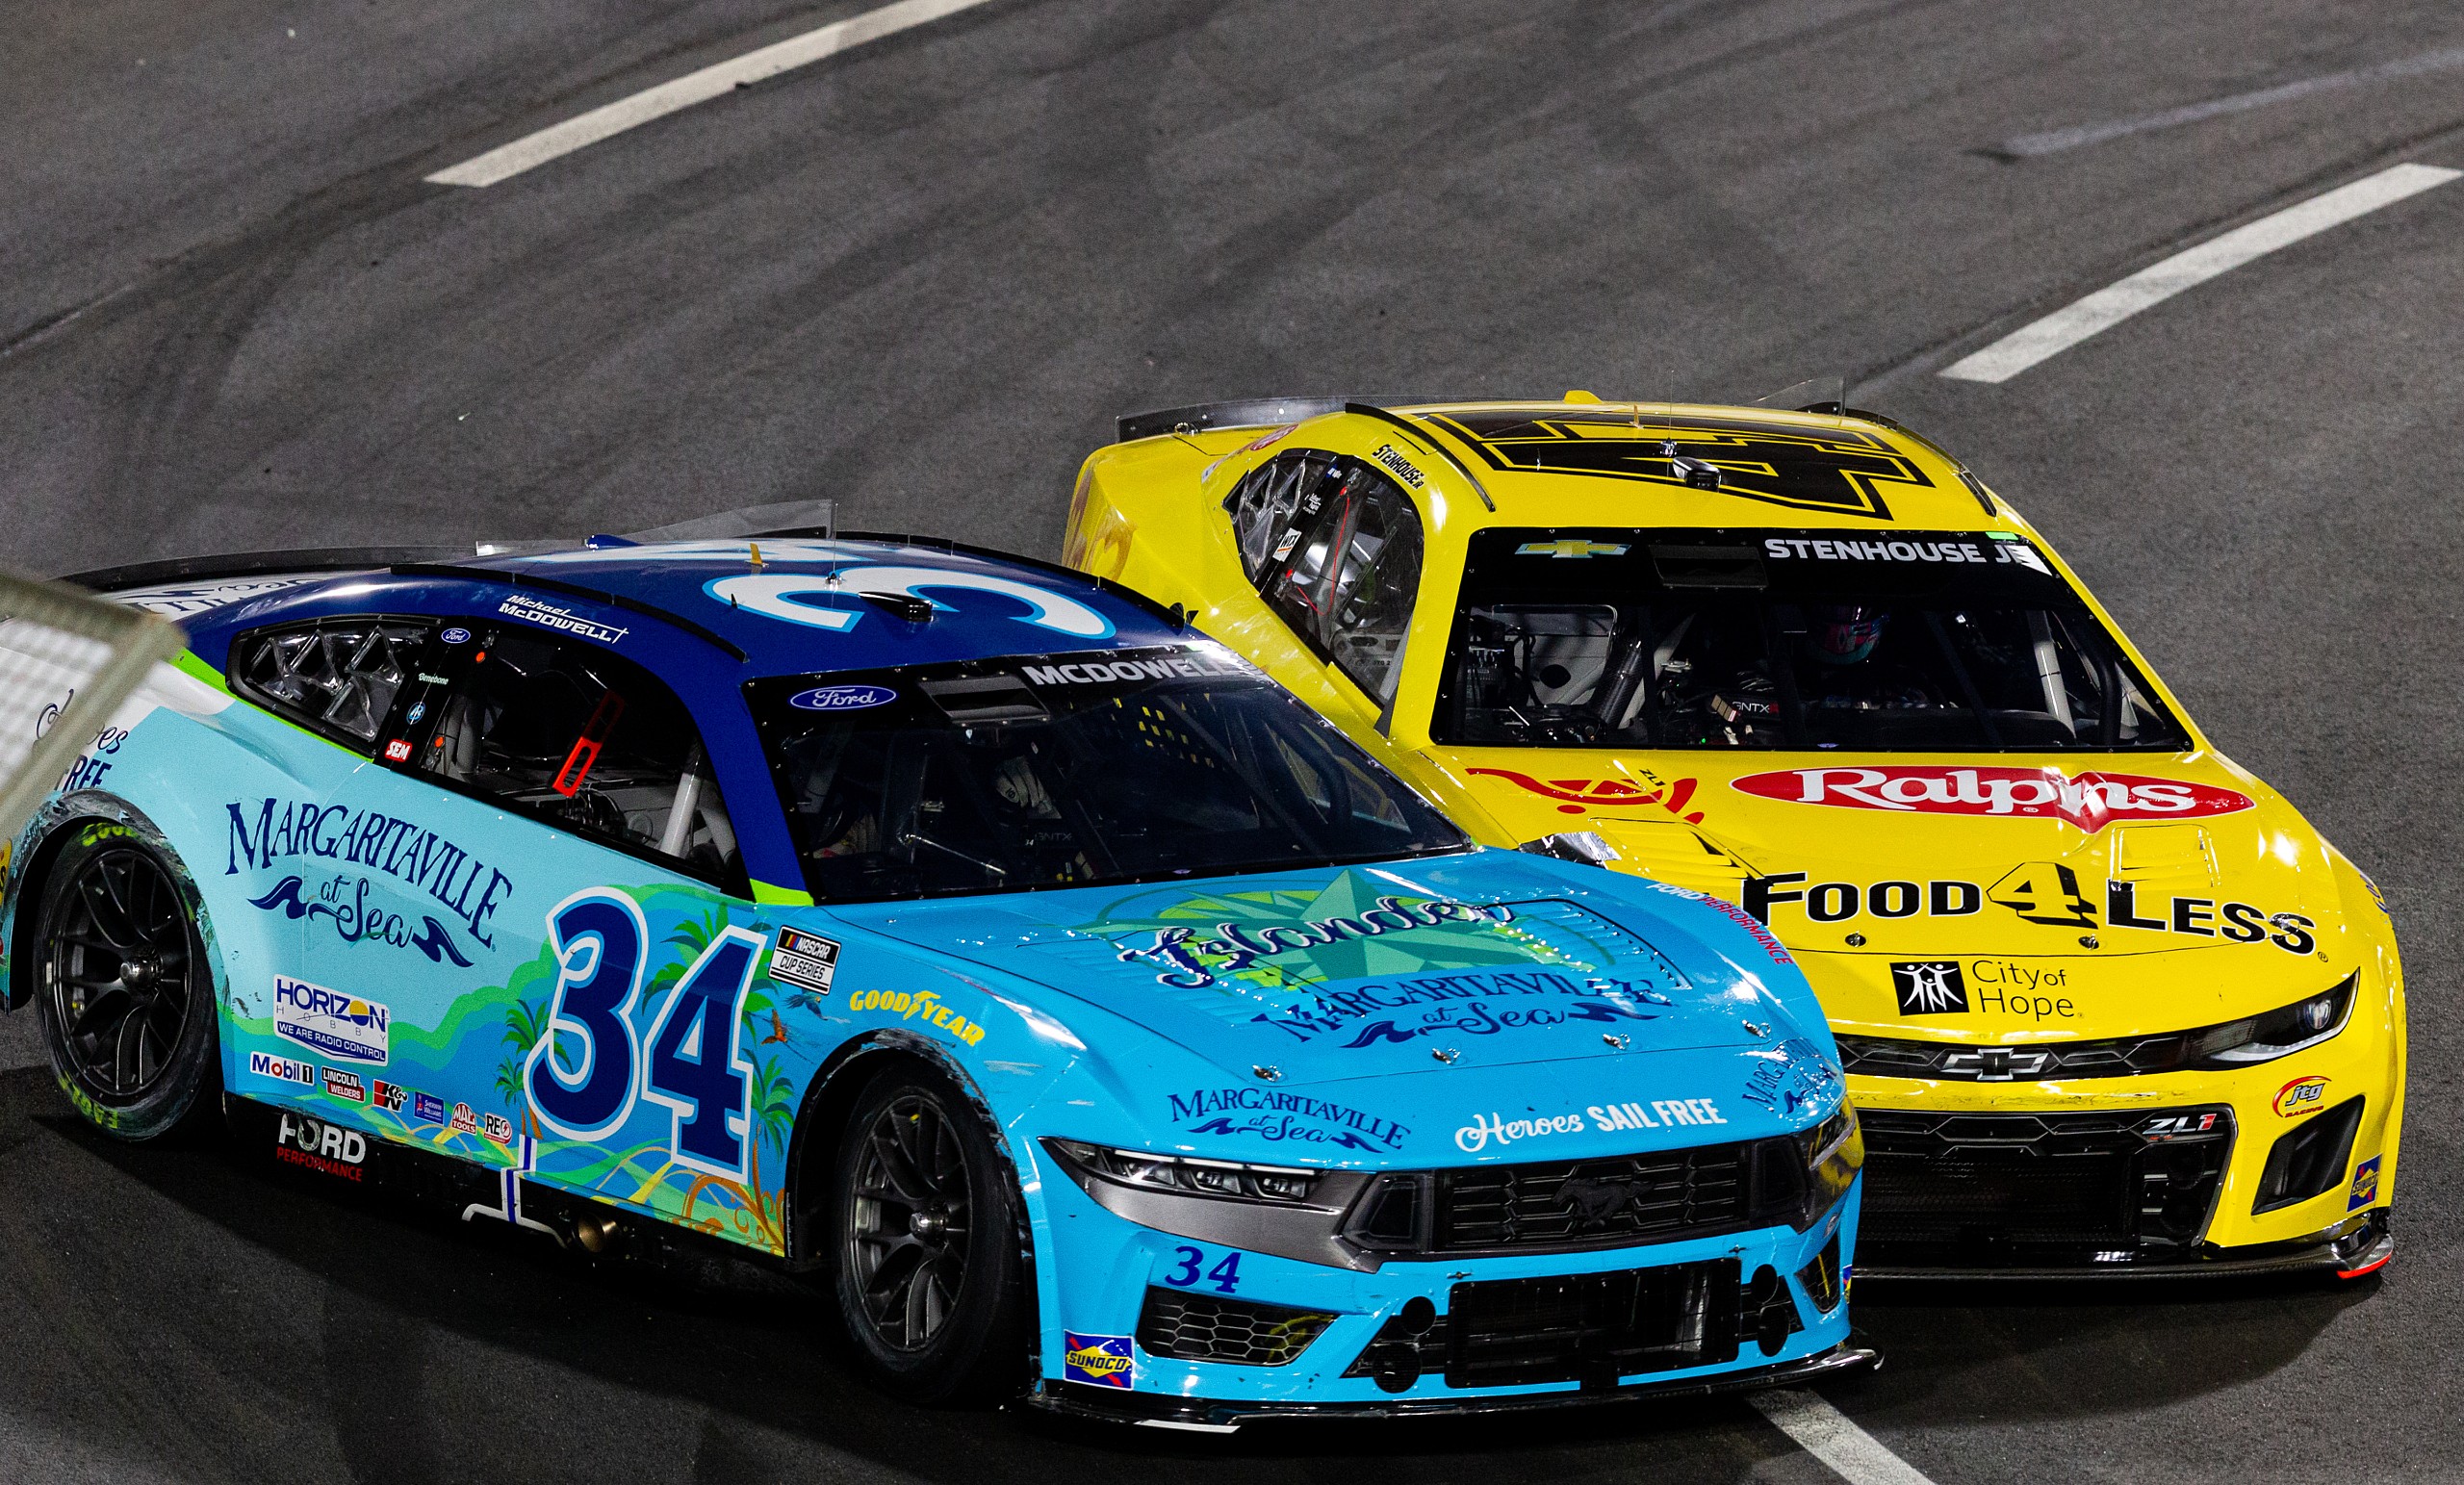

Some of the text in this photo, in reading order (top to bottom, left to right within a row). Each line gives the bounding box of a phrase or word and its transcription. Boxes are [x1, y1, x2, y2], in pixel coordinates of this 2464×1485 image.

[1372, 444, 1424, 484] STENHOUSE
[1764, 539, 1988, 563] STENHOUSE
[506, 595, 570, 616] Michael
[445, 629, 467, 641] Ford
[811, 688, 877, 707] Ford
[386, 742, 411, 760] SEM
[1639, 768, 1667, 787] ZL1
[225, 798, 512, 949] MARGARITAVILLE
[308, 875, 412, 948] at Sea
[1740, 871, 1982, 927] FOOD
[1987, 861, 2099, 930] 4
[2106, 878, 2318, 956] LESS
[1647, 883, 1794, 965] FORD PERFORMANCE
[796, 936, 831, 960] NASCAR
[780, 955, 826, 981] CUP SERIES
[1972, 960, 2066, 989] City of
[276, 978, 386, 1033] HORIZON
[850, 989, 986, 1047] GOODYEAR
[1415, 1001, 1565, 1036] at Sea
[1978, 987, 2074, 1022] Hope
[278, 1022, 386, 1062] WE ARE RADIO CONTROL
[524, 886, 768, 1185] 34
[252, 1054, 300, 1081] Mobil
[322, 1068, 358, 1088] LINCOLN
[330, 1084, 361, 1099] WELDERS
[382, 1083, 408, 1112] K&N
[2285, 1083, 2325, 1107] jtg
[451, 1121, 476, 1134] TOOLS
[452, 1105, 475, 1124] MAC
[1168, 1088, 1411, 1149] MARGARITAVILLE
[1236, 1114, 1332, 1142] at Sea
[1454, 1098, 1729, 1153] Heroes SAIL FREE
[2142, 1113, 2218, 1136] ZL1
[278, 1114, 367, 1165] FORD
[276, 1146, 363, 1182] PERFORMANCE
[1165, 1245, 1242, 1293] 34
[1067, 1352, 1130, 1370] SUNOCO
